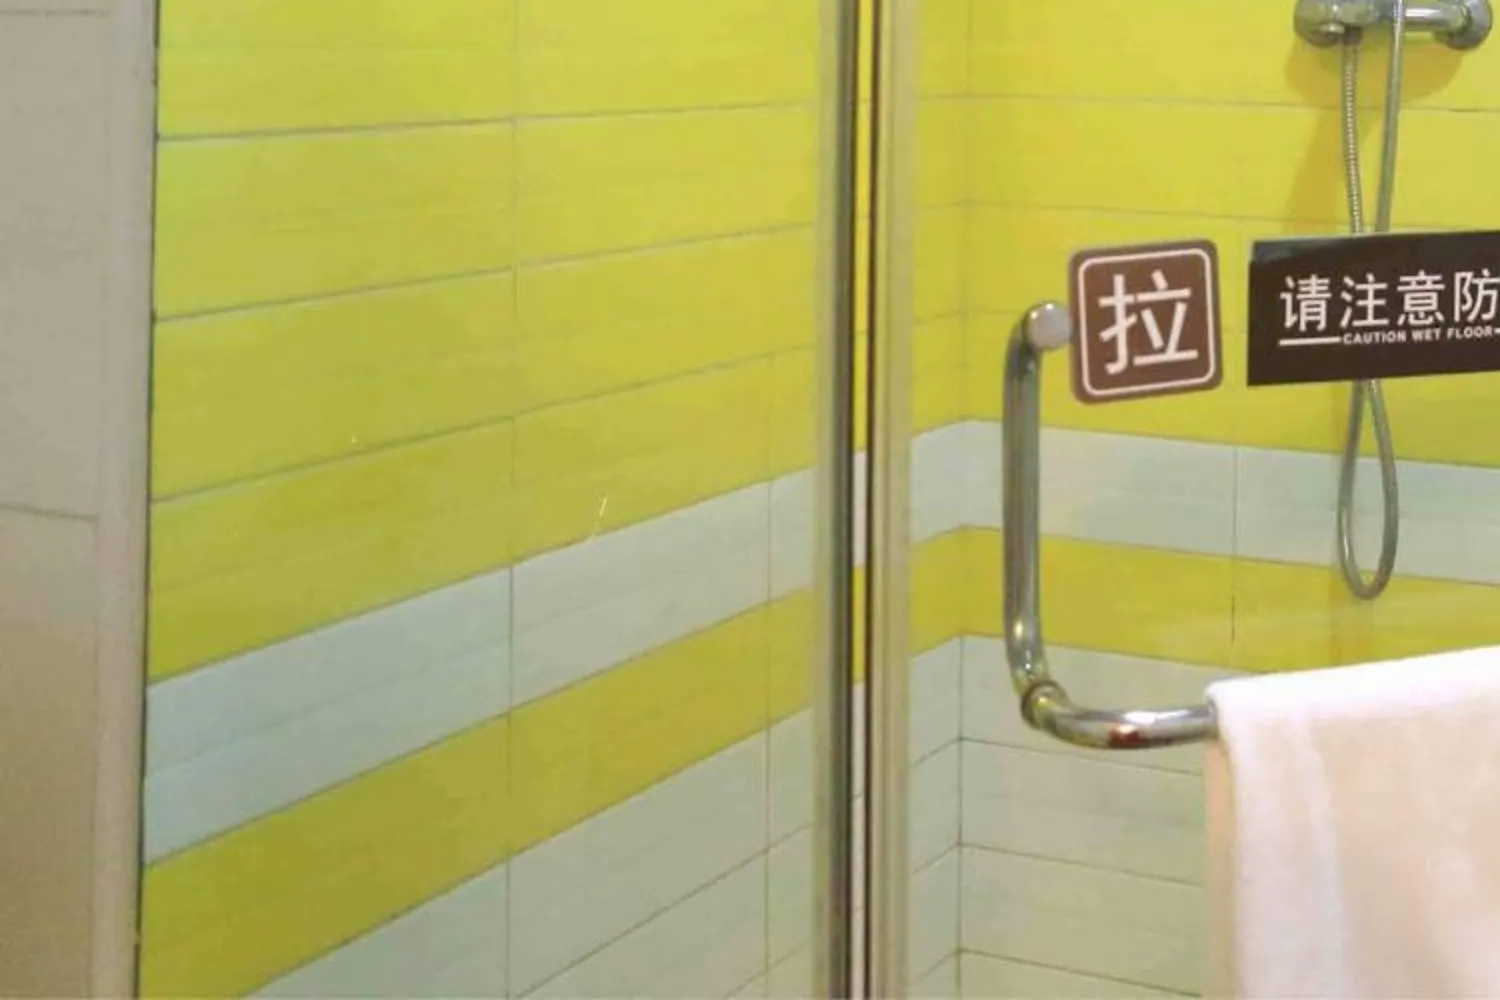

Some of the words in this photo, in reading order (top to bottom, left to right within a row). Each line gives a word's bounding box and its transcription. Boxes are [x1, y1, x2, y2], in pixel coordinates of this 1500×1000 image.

[1098, 269, 1199, 374] 拉
[1343, 330, 1407, 345] CAUTION
[1411, 328, 1441, 341] WET
[1447, 326, 1494, 339] FLOOR
